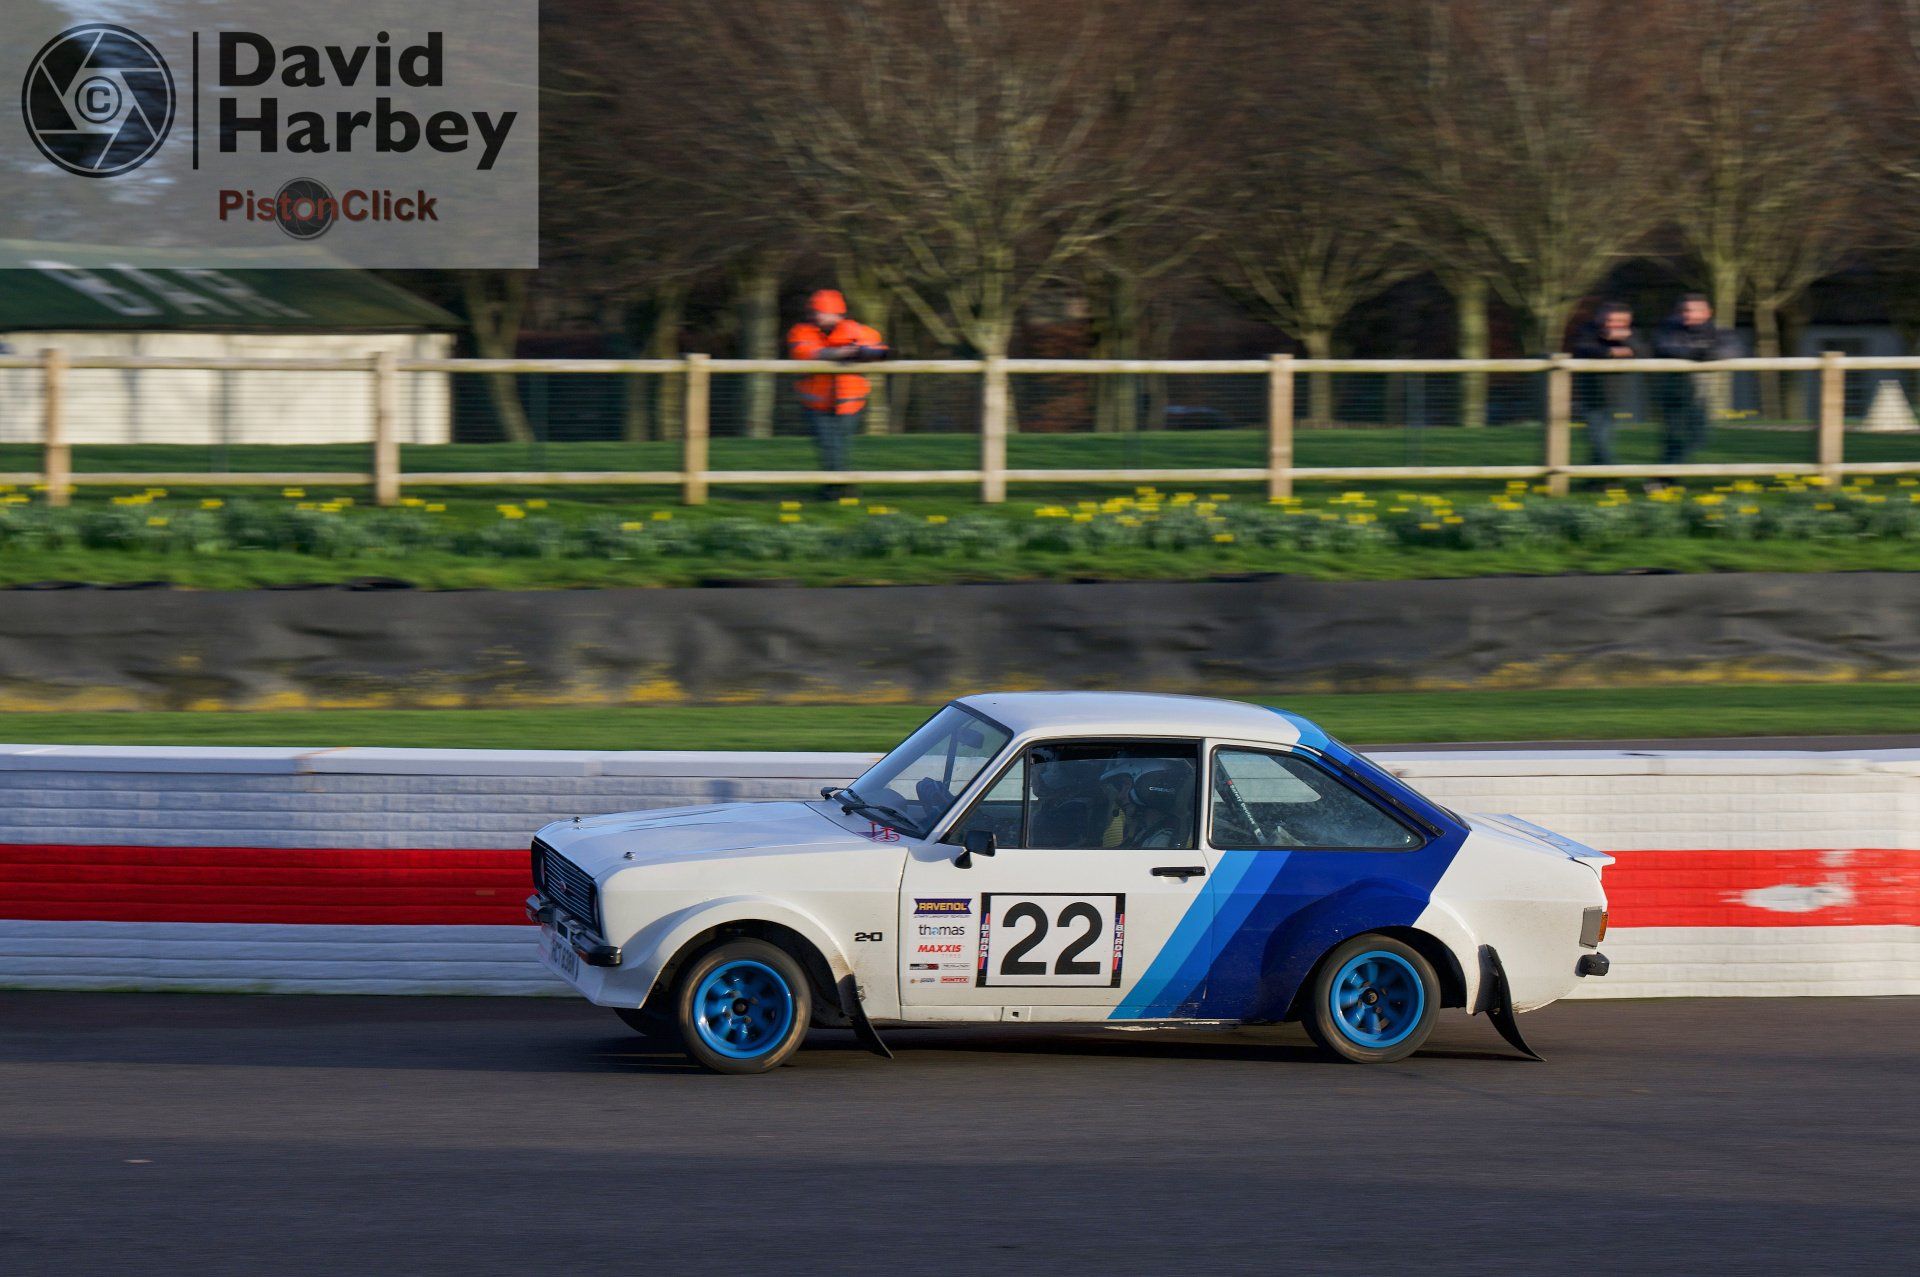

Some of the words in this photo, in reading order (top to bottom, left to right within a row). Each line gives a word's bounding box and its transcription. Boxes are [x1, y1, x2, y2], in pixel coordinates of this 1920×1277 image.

[918, 902, 968, 911] RAVENOL
[918, 924, 965, 936] thomas
[979, 924, 990, 957] BTRDA
[1000, 901, 1103, 975] 22
[1113, 925, 1125, 957] BTRDA
[917, 944, 962, 953] MAXXIS
